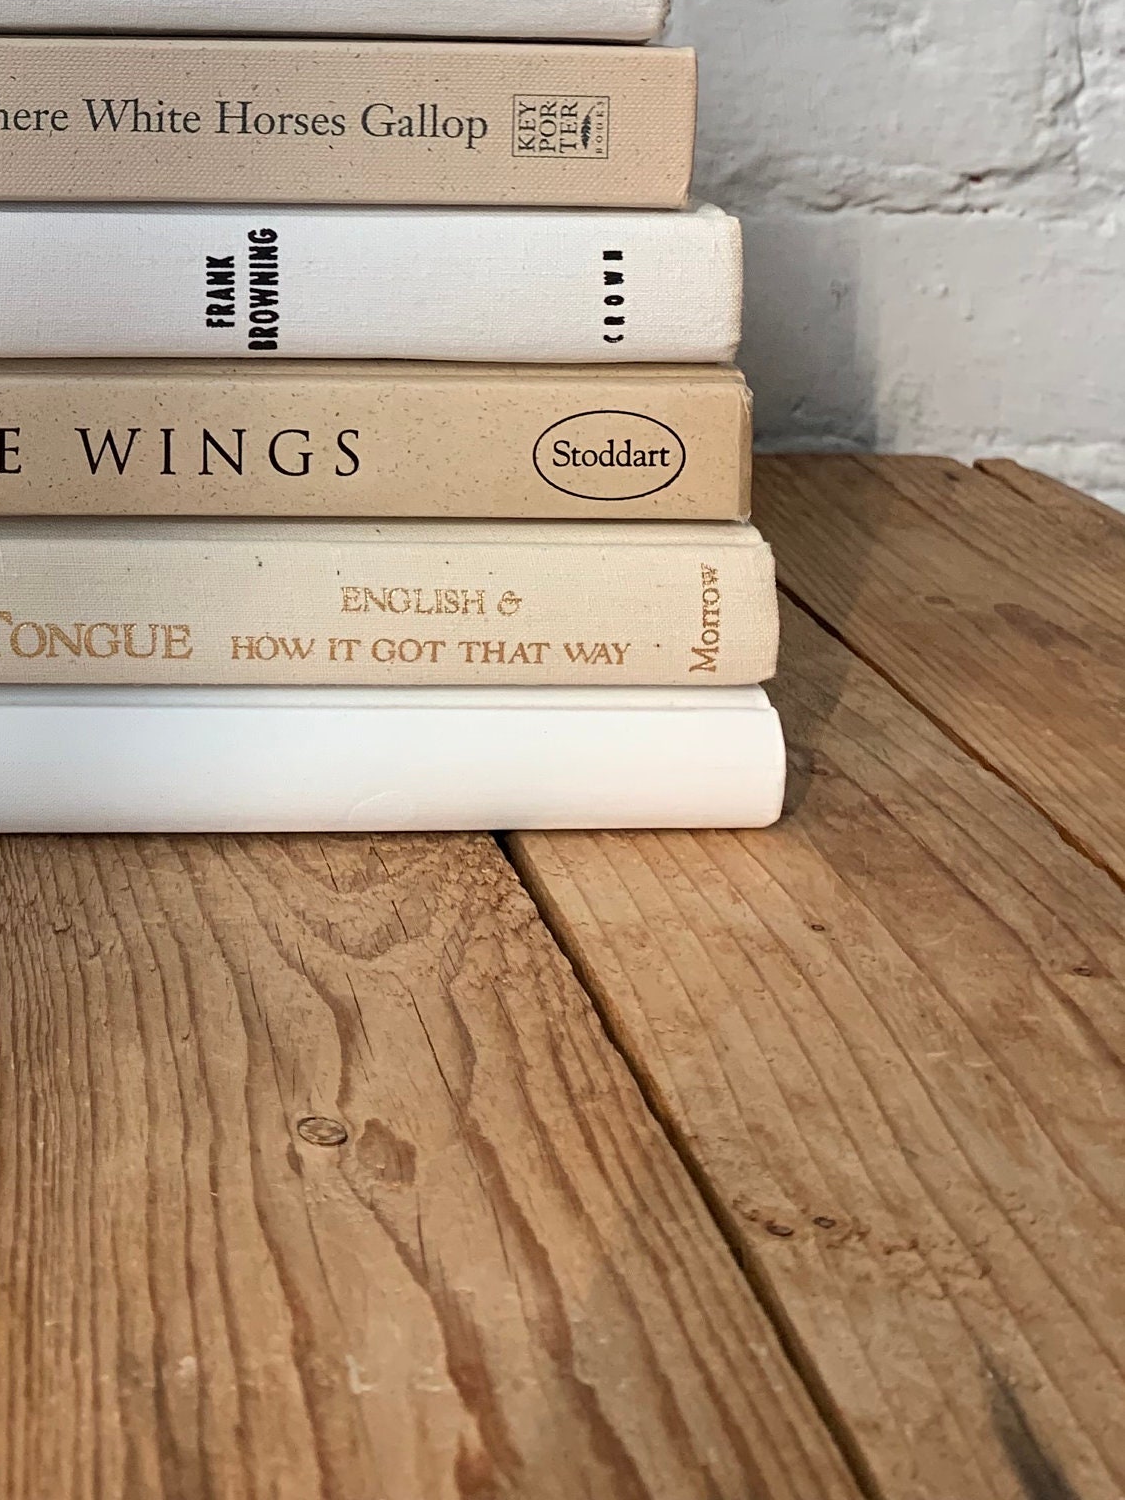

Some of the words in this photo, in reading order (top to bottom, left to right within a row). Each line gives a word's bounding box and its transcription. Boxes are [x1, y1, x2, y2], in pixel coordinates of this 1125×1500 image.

[82, 98, 202, 135] White
[215, 100, 346, 137] Horses
[361, 102, 488, 149] Gallop
[517, 101, 536, 152] KEY
[538, 101, 557, 153] POR
[559, 102, 578, 154] TER
[206, 255, 235, 329] FRANK
[248, 227, 278, 351] BROWNING
[603, 250, 624, 344] CROWN
[75, 427, 362, 478] WINGS
[551, 439, 671, 468] Stoddart
[340, 586, 486, 616] ENGLISH
[689, 562, 719, 673] Morrow
[230, 634, 314, 661] HOW
[329, 637, 360, 662] IT
[372, 637, 446, 664] GOT
[457, 640, 551, 666] THAT
[563, 640, 631, 667] WAY
